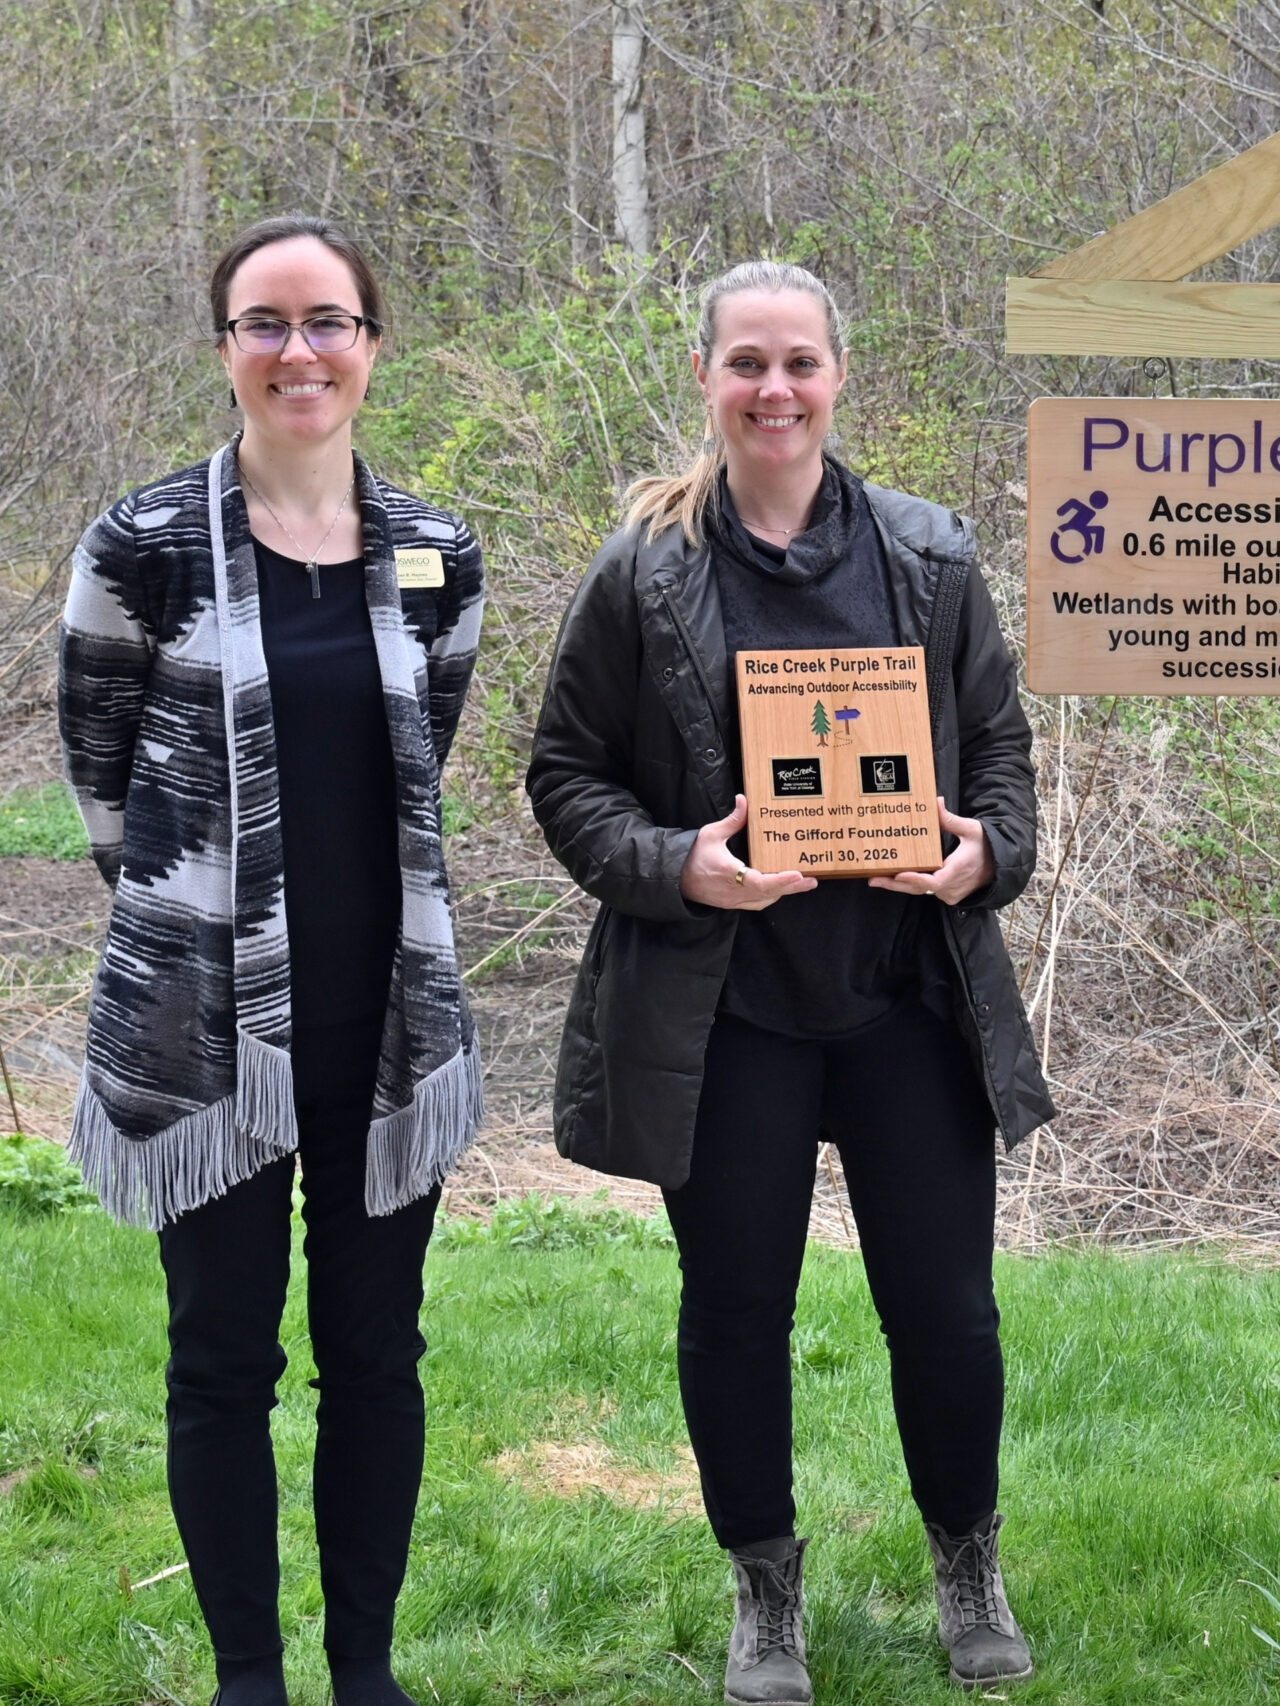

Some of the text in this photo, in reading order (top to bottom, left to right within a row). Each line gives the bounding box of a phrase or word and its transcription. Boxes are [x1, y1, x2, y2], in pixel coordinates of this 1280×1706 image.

[1122, 532, 1166, 556] 0.6
[1175, 532, 1236, 557] mile
[1052, 591, 1174, 615] Wetlands
[1182, 593, 1237, 616] with
[1107, 629, 1190, 652] young
[1199, 625, 1246, 647] and
[745, 656, 916, 674] Rice Creek Purple Trail
[748, 680, 917, 695] Advancing Outdoor Accessibility
[760, 802, 927, 818] Presented with gratitude to
[763, 825, 928, 842] The Gifford Foundation
[799, 848, 898, 865] April 30, 2026
